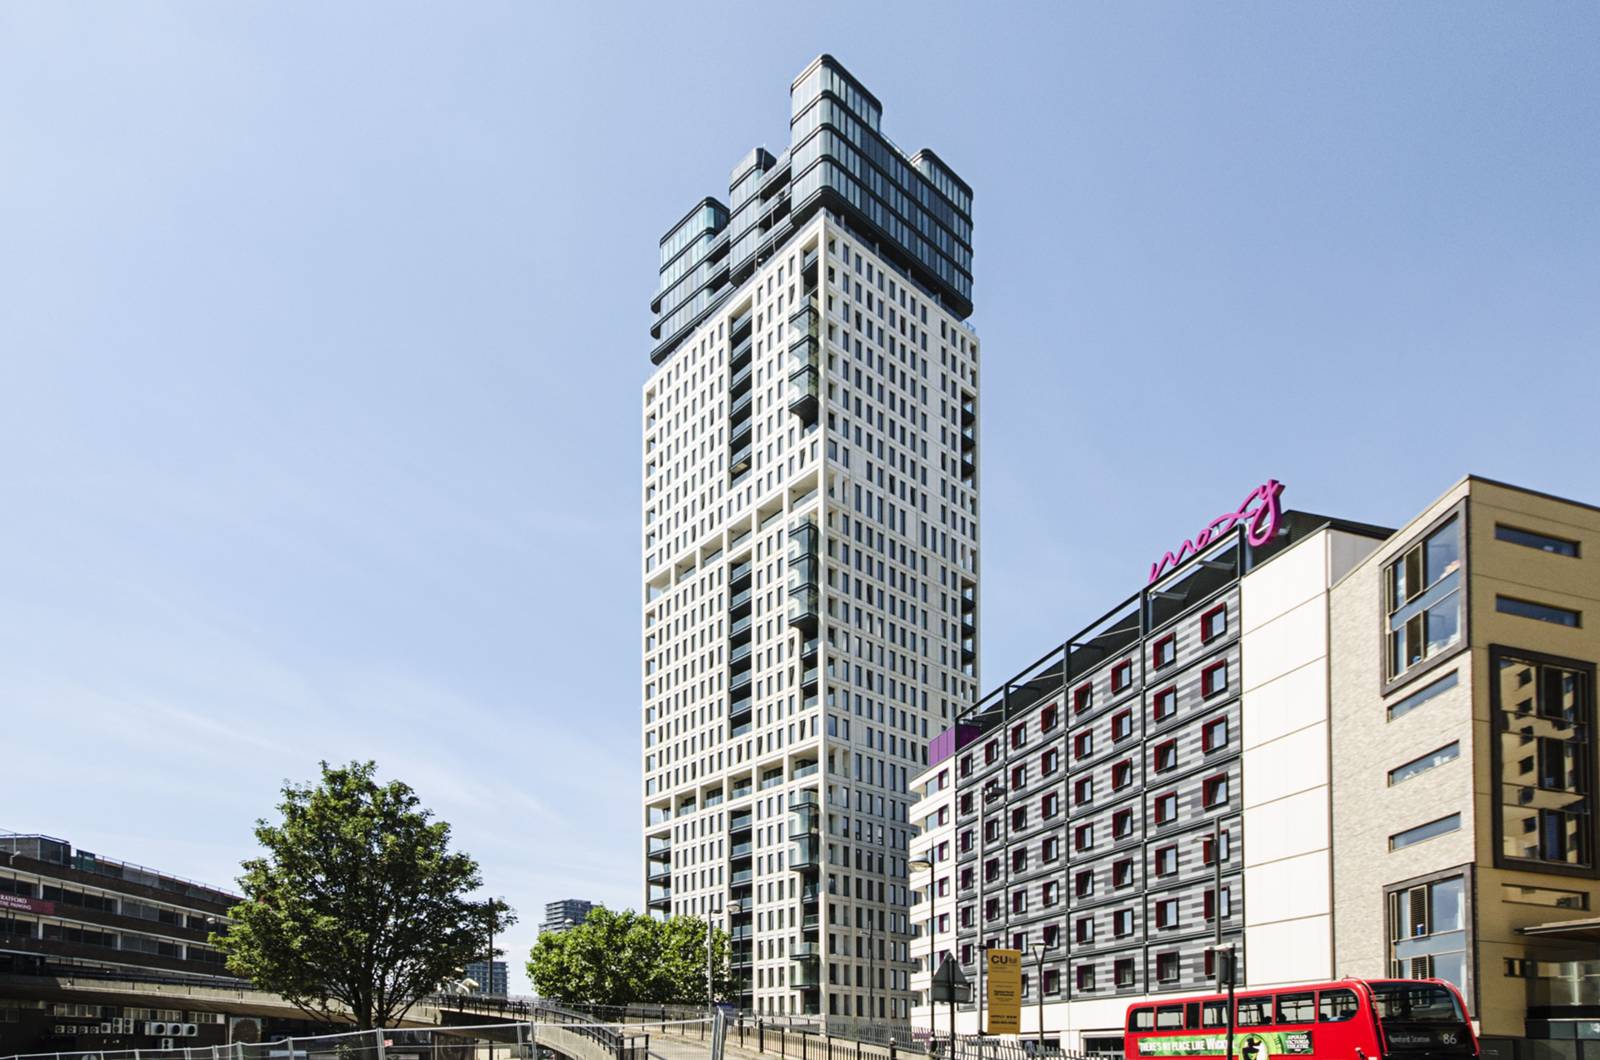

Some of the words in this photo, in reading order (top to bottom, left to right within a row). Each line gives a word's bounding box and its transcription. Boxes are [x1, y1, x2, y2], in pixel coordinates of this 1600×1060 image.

[991, 955, 1008, 964] CU
[1442, 1033, 1457, 1044] 86
[1171, 1040, 1191, 1050] PLACE
